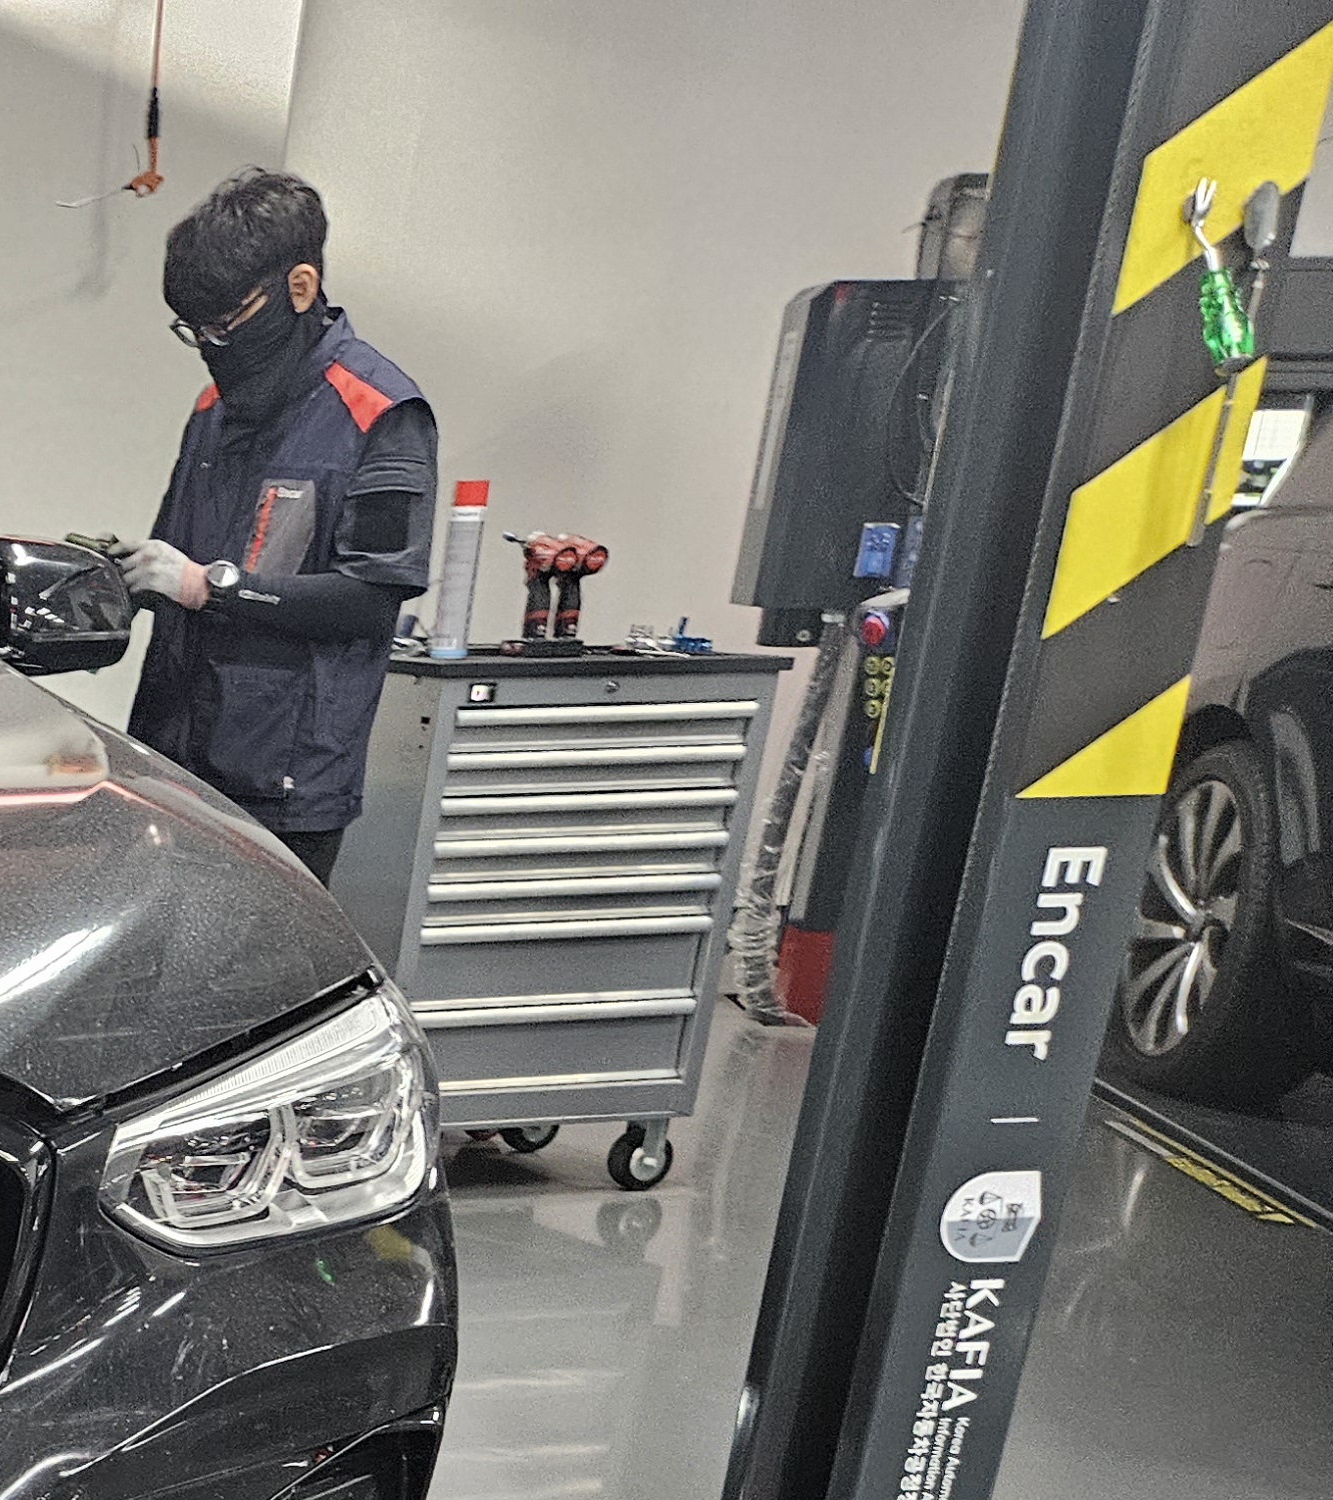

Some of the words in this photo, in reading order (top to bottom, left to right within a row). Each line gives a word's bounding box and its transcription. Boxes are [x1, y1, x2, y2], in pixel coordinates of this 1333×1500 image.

[1004, 846, 1109, 1062] Encar
[930, 1281, 968, 1357] 사단법인
[942, 1278, 1006, 1412] KAFIA
[923, 1417, 953, 1491] Information
[949, 1416, 971, 1455] Korea
